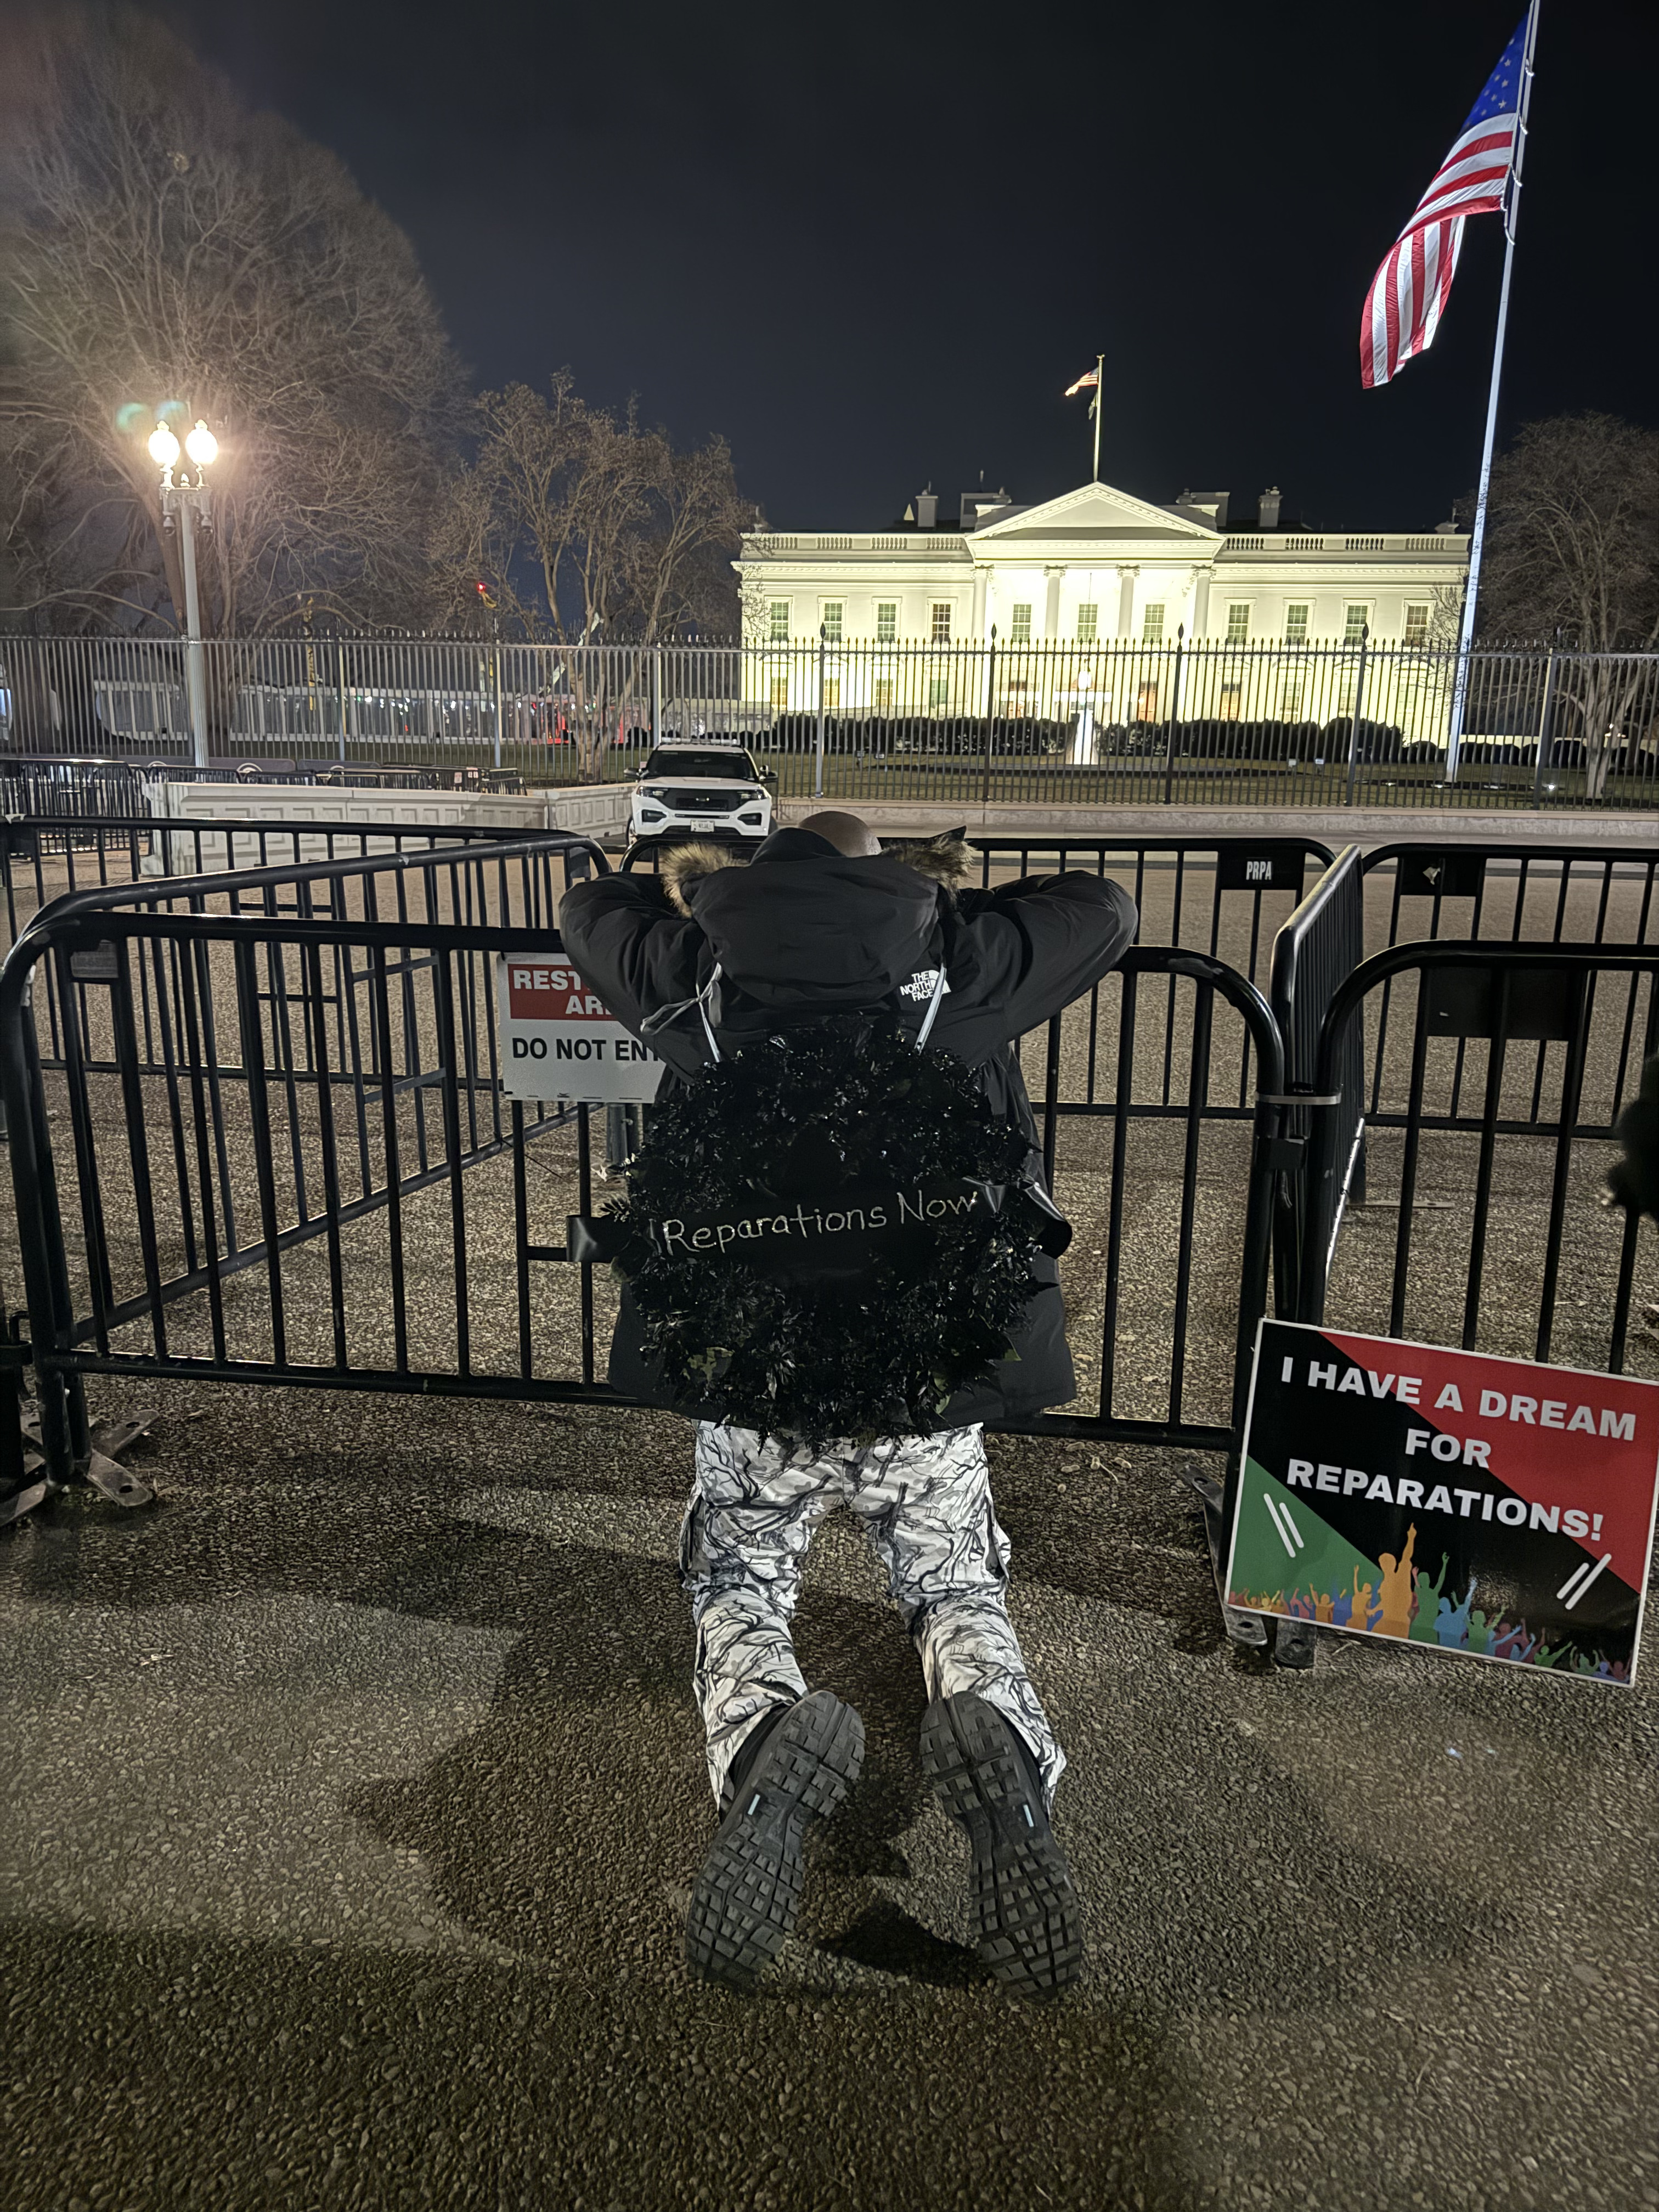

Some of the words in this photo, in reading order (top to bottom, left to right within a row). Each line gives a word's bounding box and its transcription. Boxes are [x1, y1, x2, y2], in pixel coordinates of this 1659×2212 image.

[1246, 861, 1272, 881] PRPA
[512, 969, 590, 991] REST
[900, 979, 932, 996] NORTH
[911, 970, 930, 983] THE
[911, 988, 934, 1002] FACE
[512, 1037, 548, 1059] DO
[556, 1039, 607, 1060] NOT
[662, 1204, 888, 1256] Reparations
[896, 1189, 978, 1226] Now
[1280, 1356, 1294, 1383] I
[1307, 1361, 1423, 1405] HAVE
[1434, 1384, 1464, 1413] A
[1479, 1389, 1637, 1442] DREAM
[1404, 1428, 1492, 1469] FOR
[1286, 1458, 1604, 1542] REPARATIONS!
